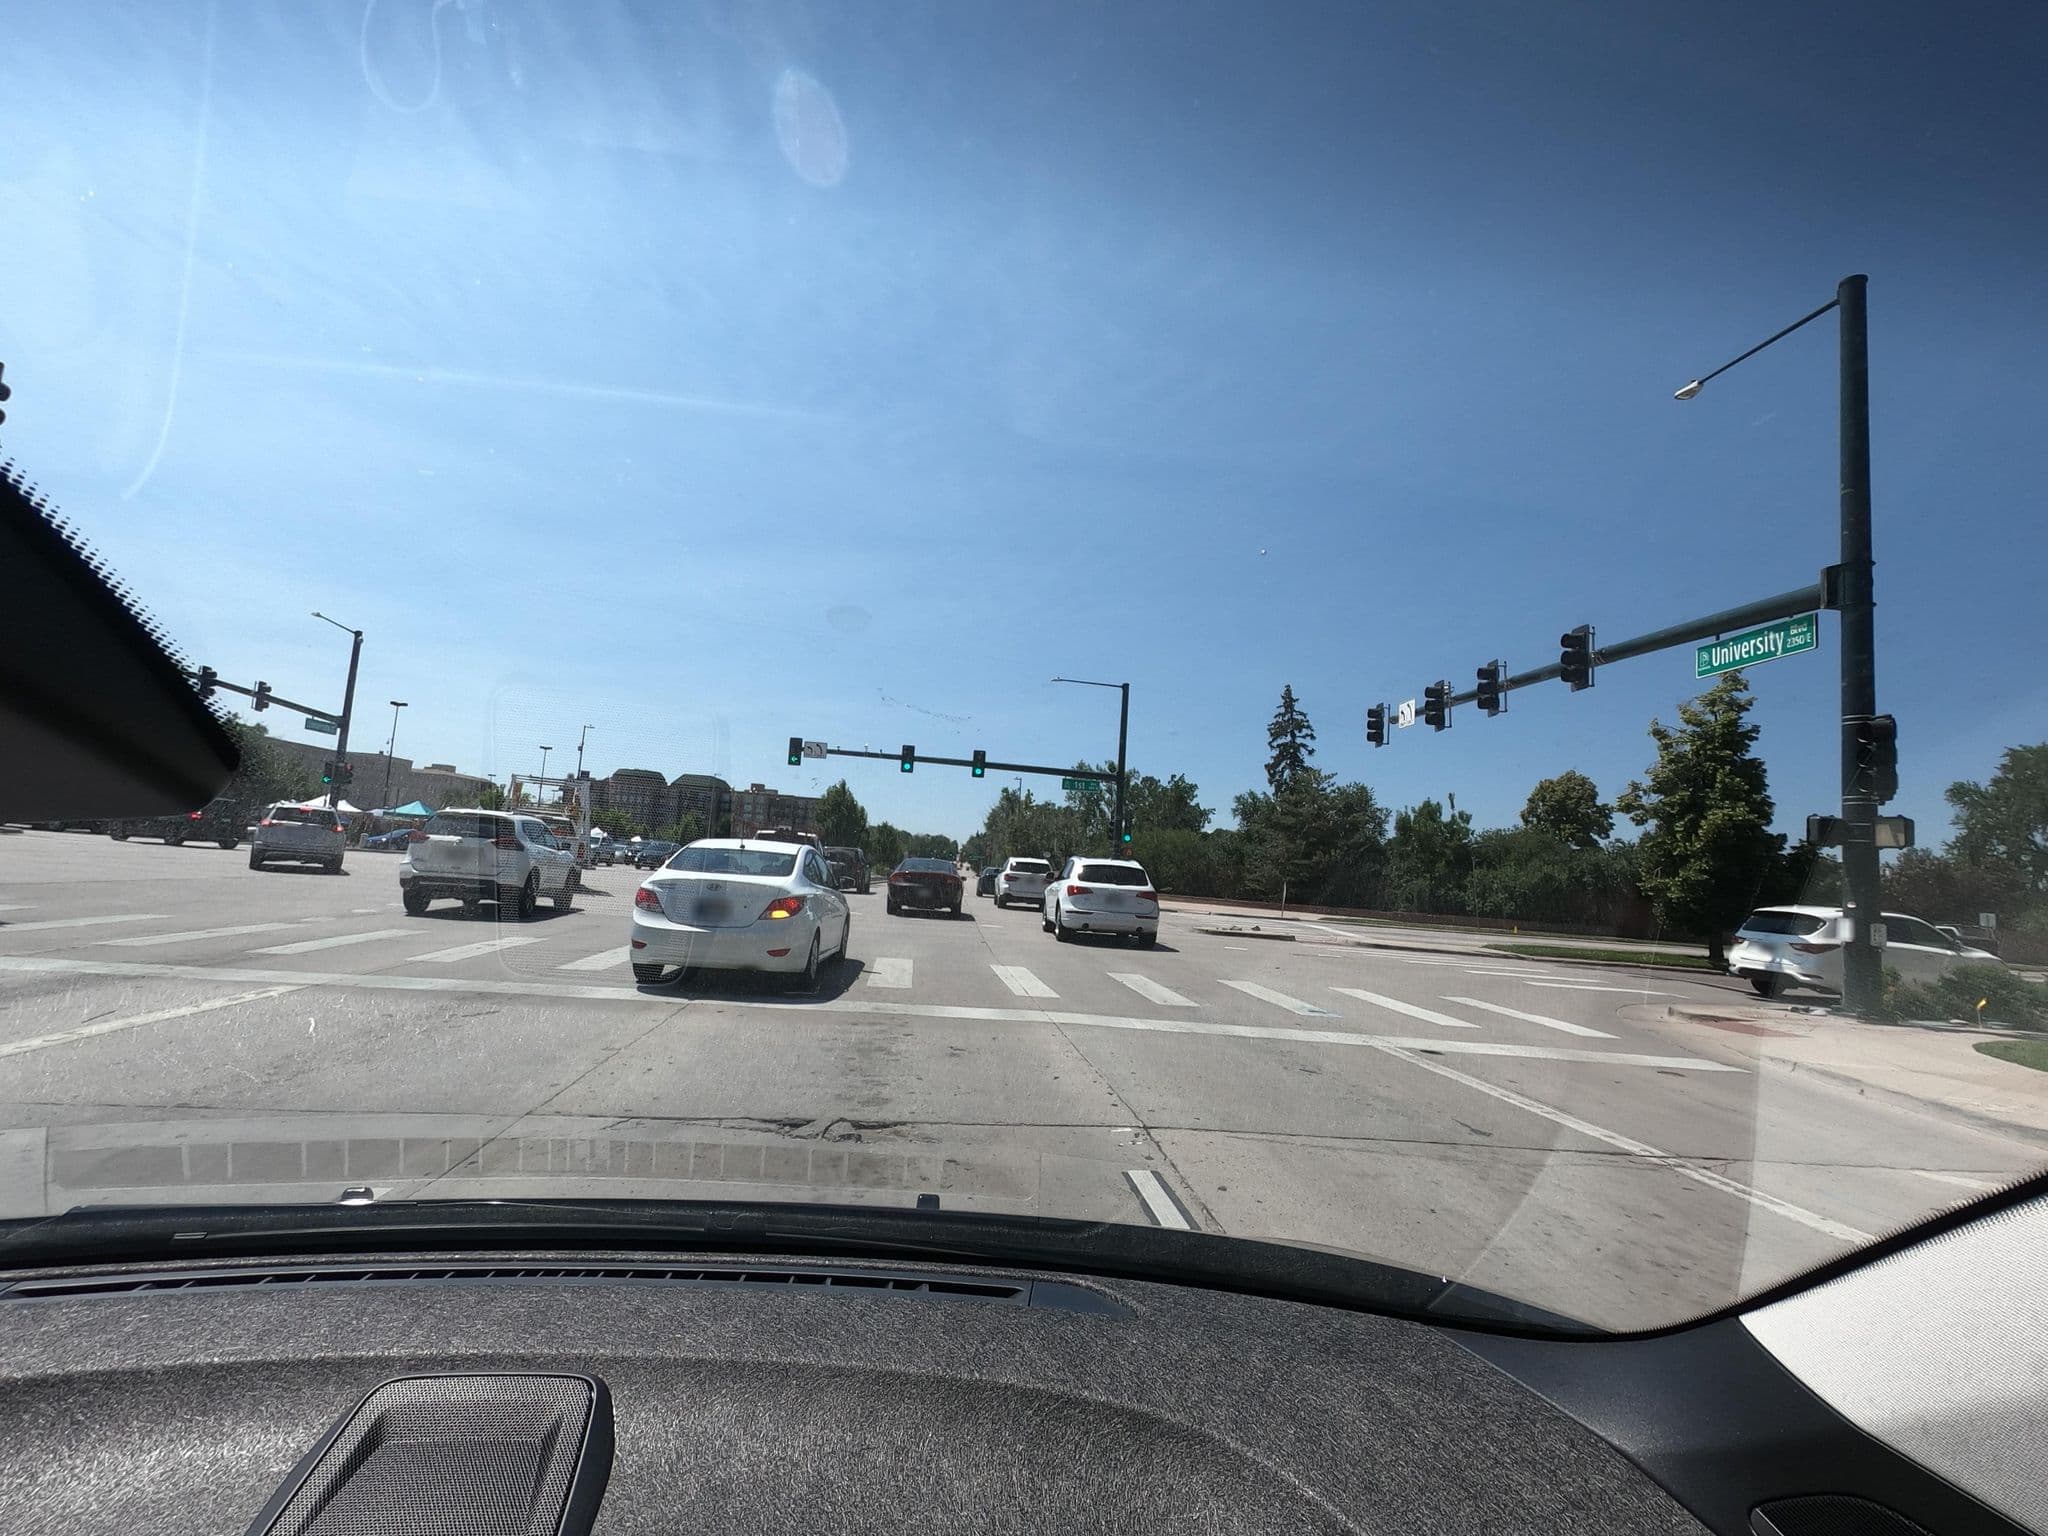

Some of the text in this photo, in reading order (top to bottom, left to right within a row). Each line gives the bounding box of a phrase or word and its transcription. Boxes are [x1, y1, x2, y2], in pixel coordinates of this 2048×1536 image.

[1712, 631, 1784, 667] University
[1786, 632, 1812, 648] 2350 E
